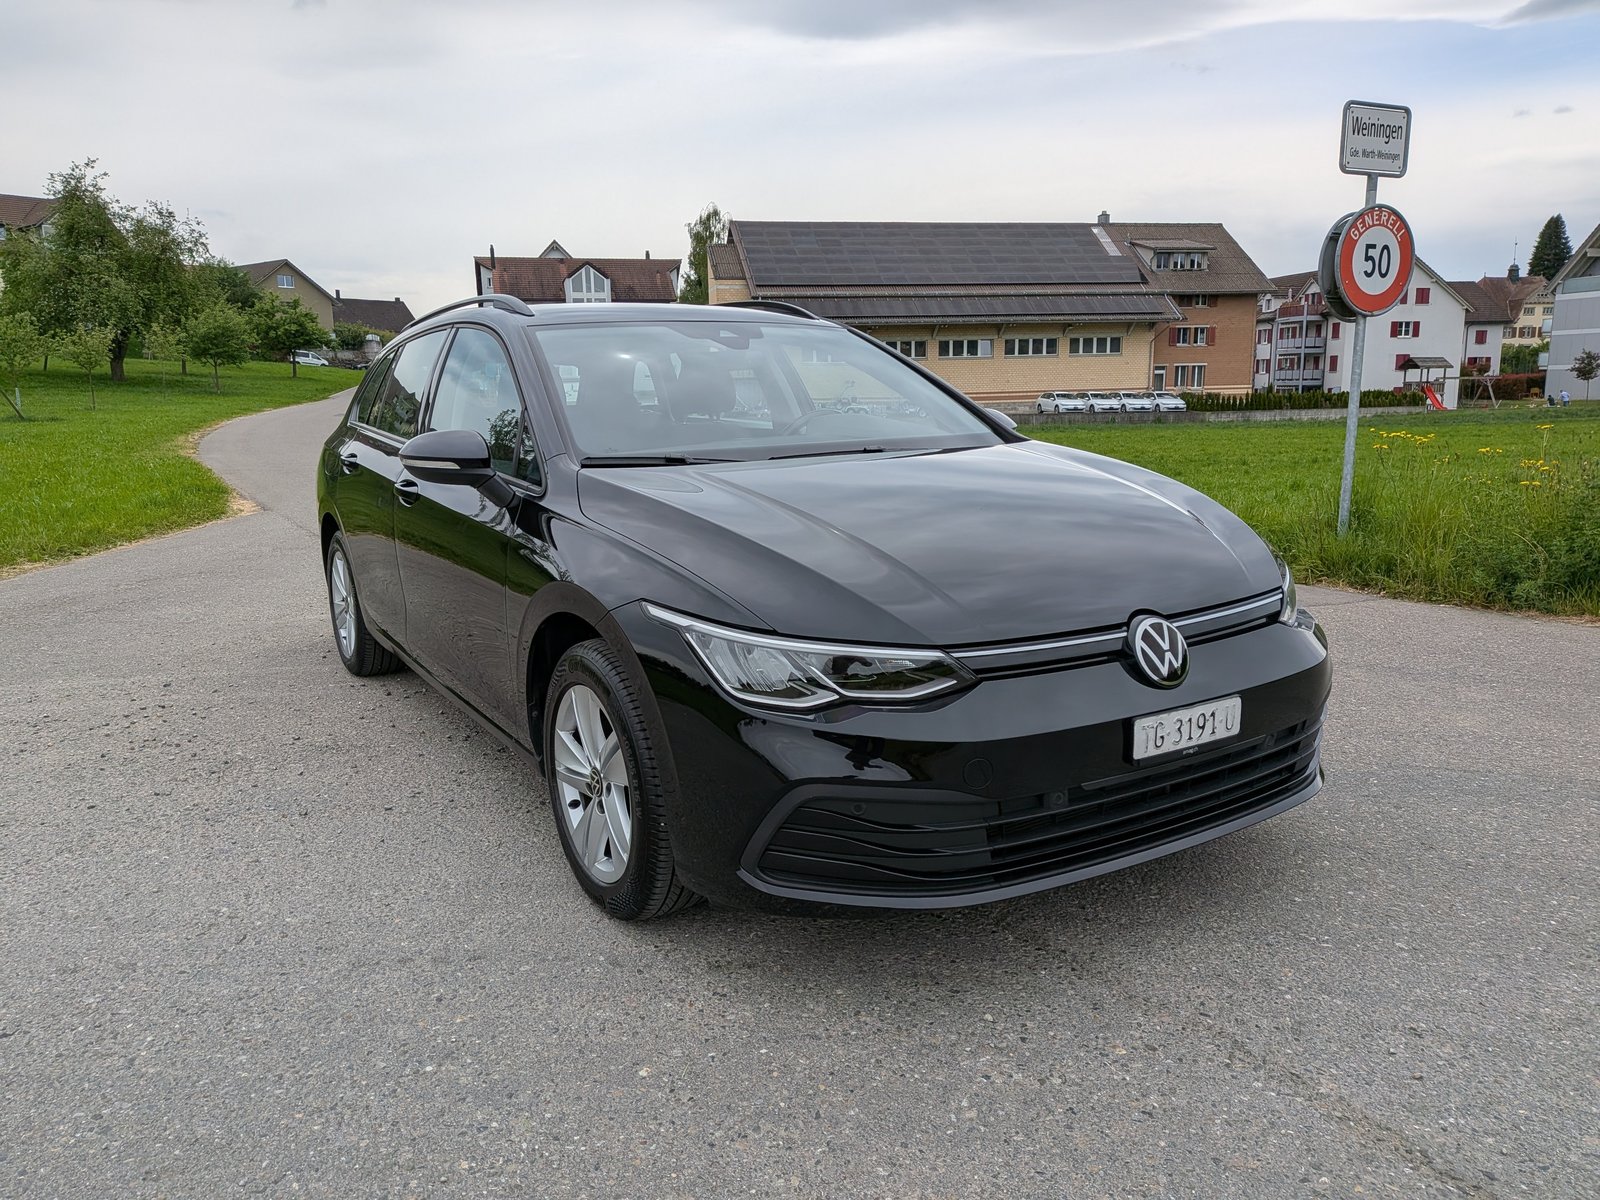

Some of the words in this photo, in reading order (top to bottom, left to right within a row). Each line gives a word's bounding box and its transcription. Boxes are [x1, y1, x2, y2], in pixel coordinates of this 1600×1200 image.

[1352, 115, 1403, 144] Weiningen
[1349, 147, 1361, 158] Gde.
[1362, 148, 1401, 164] Warth-Weiningen
[1350, 210, 1405, 242] GENERELL
[1363, 243, 1391, 279] 50
[1138, 619, 1185, 680] VW
[1172, 708, 1217, 746] 3191
